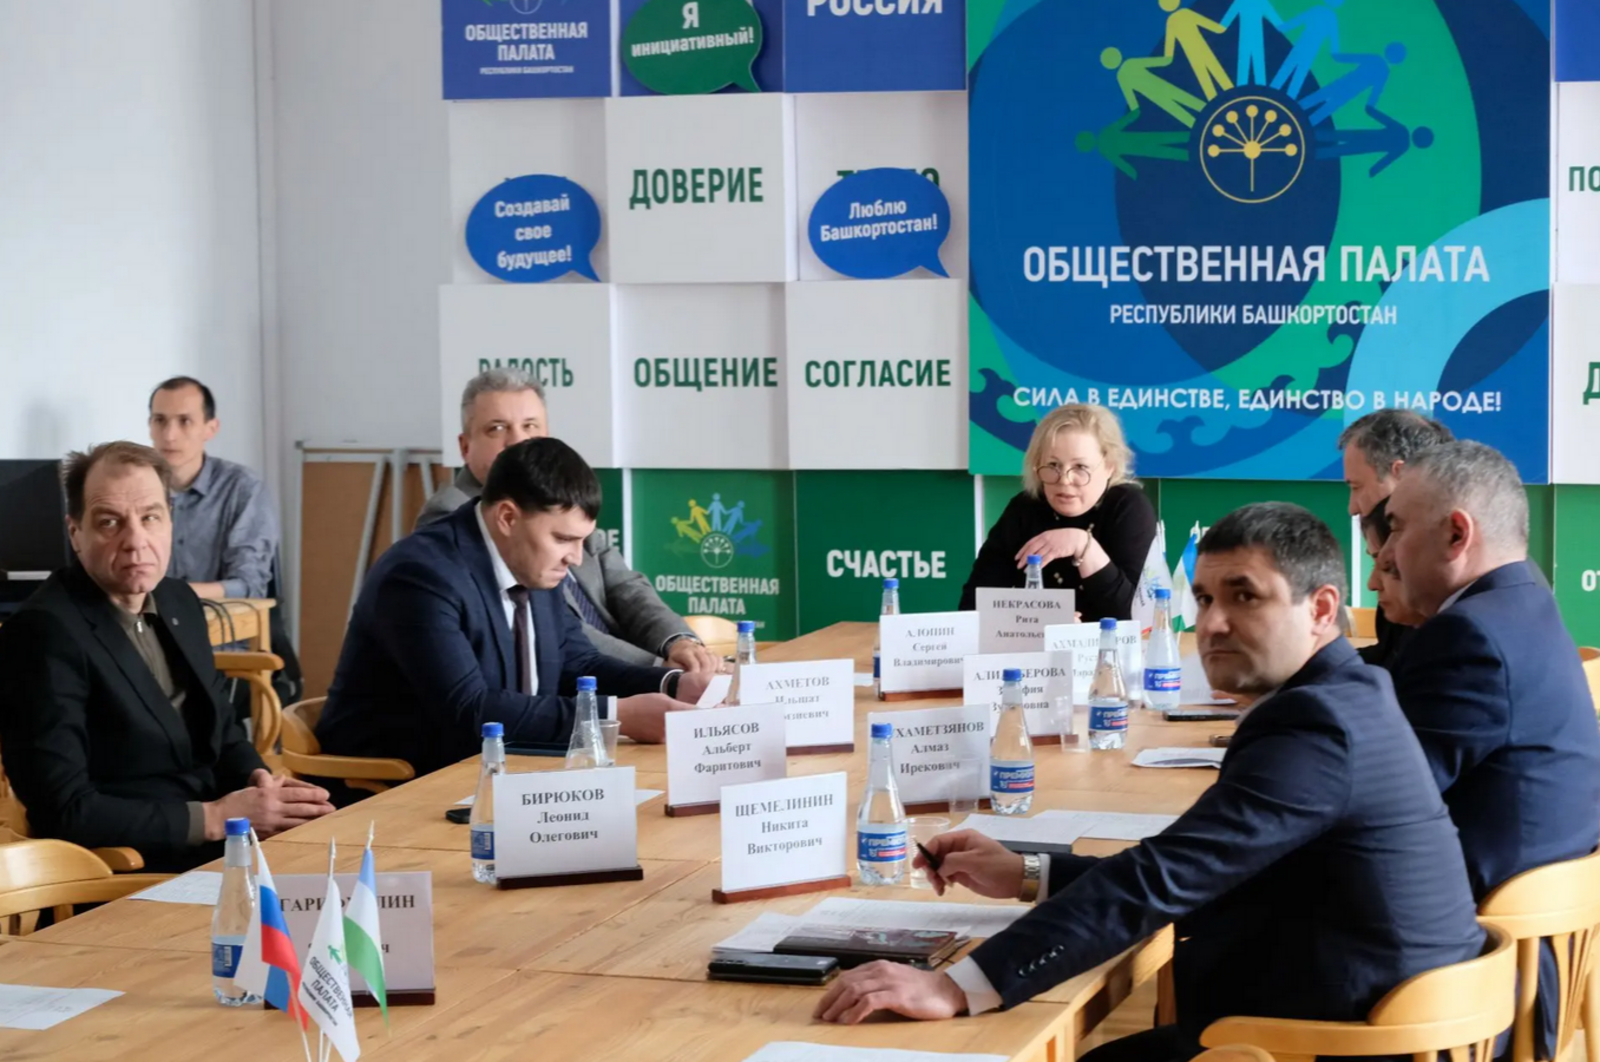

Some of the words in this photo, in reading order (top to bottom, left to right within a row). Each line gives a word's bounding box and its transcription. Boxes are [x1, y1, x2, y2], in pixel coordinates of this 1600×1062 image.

[682, 2, 699, 29] Я
[465, 22, 588, 42] ОБЩЕСТВЕННАЯ
[631, 27, 754, 57] инициативный!
[498, 44, 555, 61] ПАЛАТА
[629, 167, 763, 210] ДОВЕРИЕ
[494, 194, 570, 217] Создавай
[849, 199, 907, 219] Люблю
[515, 225, 552, 241] свое
[820, 213, 938, 242] Башкортостан!
[497, 245, 572, 271] будущее!
[1023, 245, 1325, 288] ОБЩЕСТВЕННАЯ
[1341, 245, 1490, 282] ПАЛАТА
[1110, 305, 1236, 324] РЕСПУБЛИКИ
[1242, 305, 1397, 324] БАШКОРТОСТАН
[634, 357, 778, 391] ОБЩЕНИЕ
[805, 359, 951, 388] СОГЛАСИЕ
[1013, 387, 1079, 407] СИЛА
[1088, 388, 1100, 405] В
[1108, 388, 1230, 410] ЕДИНСТВЕ,
[1238, 389, 1365, 411] ЕДИНСТВО
[1373, 391, 1386, 410] В
[1394, 391, 1501, 413] НАРОДЕ!
[827, 550, 946, 579] СЧАСТЬЕ
[655, 575, 780, 595] ОБЩЕСТВЕННАЯ
[688, 597, 746, 615] ПАЛАТА
[766, 676, 830, 690] АХМЕТОВ
[694, 722, 760, 739] ИЛЬЯСОВ
[702, 742, 752, 756] Альберт
[911, 743, 949, 754] Алмаз
[694, 759, 761, 775] Фаритович
[900, 762, 960, 776] Ирекович
[521, 788, 605, 806] БИРЮКОВ
[735, 794, 833, 817] ЩЕМЕЛИНИН
[537, 812, 589, 824] Леонид
[761, 818, 808, 834] Никита
[529, 830, 598, 844] Олегович
[747, 836, 822, 855] Викторович
